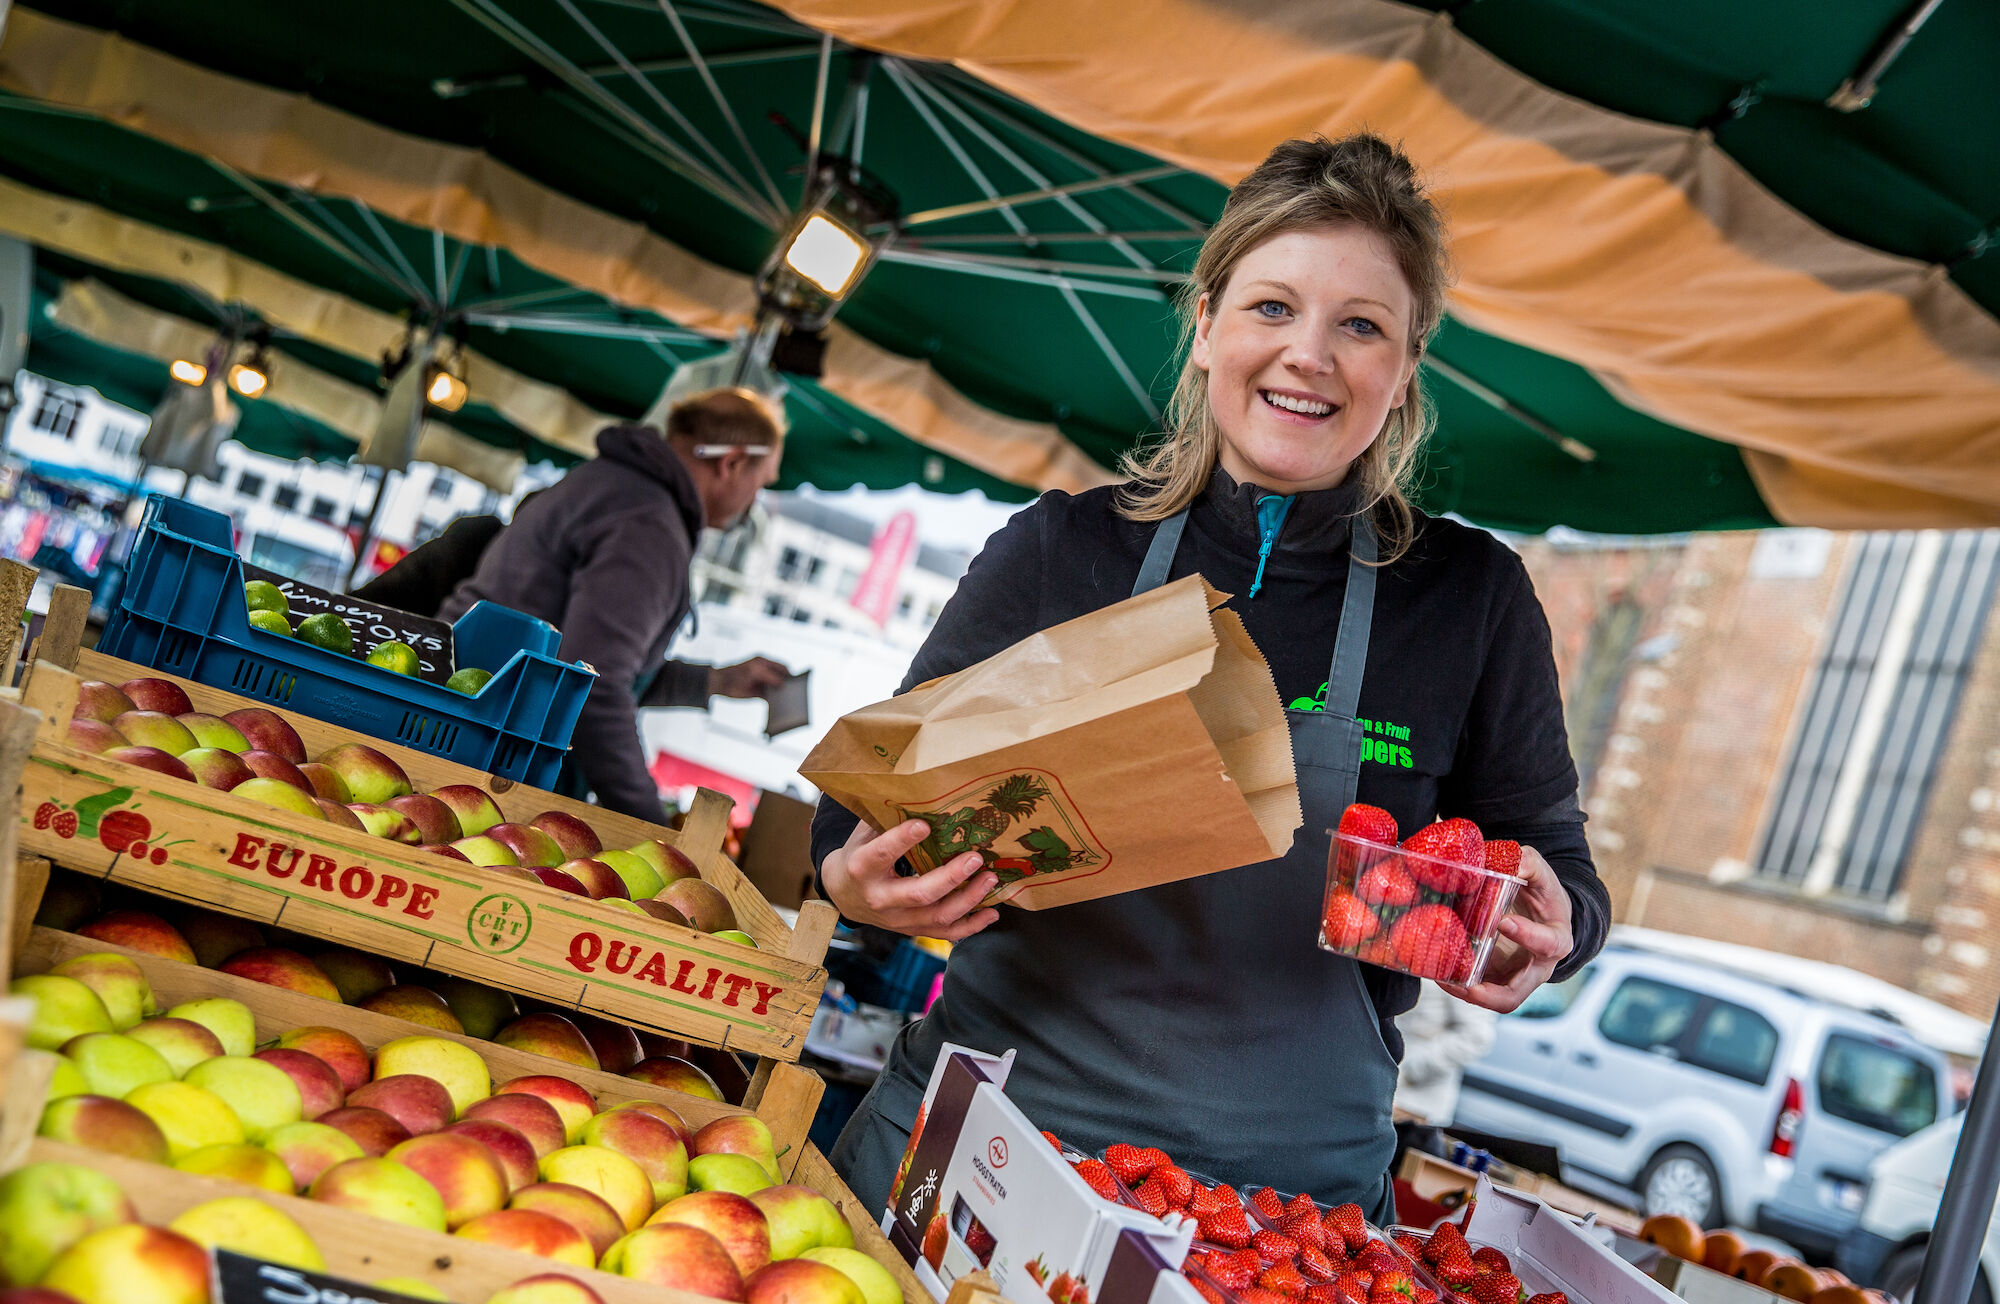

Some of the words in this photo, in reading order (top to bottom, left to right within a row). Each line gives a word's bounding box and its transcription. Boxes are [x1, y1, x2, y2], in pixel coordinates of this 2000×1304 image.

[1374, 721, 1384, 735] &
[1385, 721, 1411, 742] Fruit
[227, 832, 440, 921] EUROPE
[565, 932, 783, 1016] QUALITY
[972, 1154, 1008, 1200] HOOGSTRATEN
